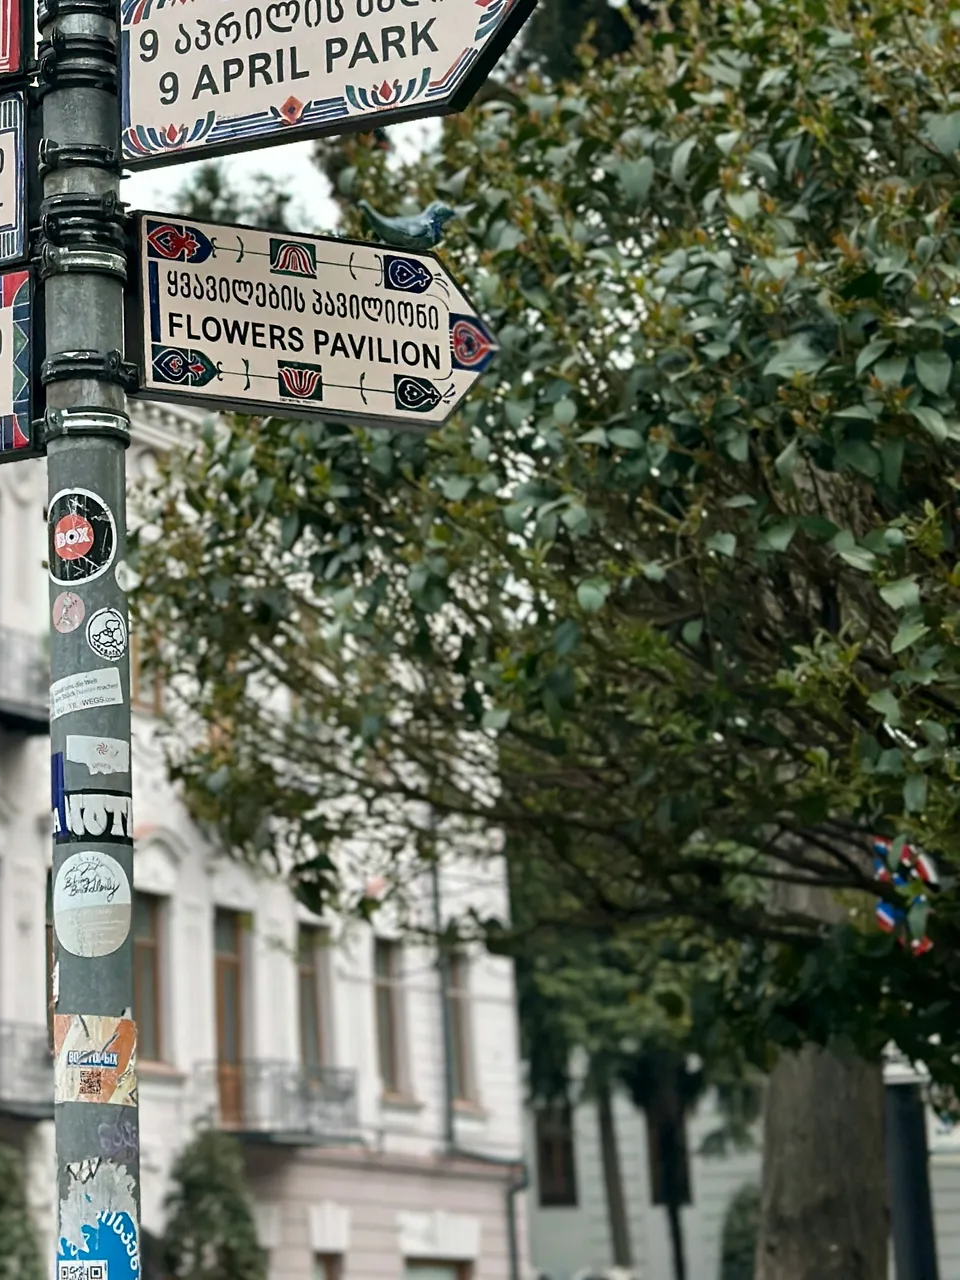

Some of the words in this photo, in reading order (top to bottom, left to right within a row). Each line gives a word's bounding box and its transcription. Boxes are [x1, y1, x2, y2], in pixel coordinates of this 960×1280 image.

[139, 29, 159, 62] 9
[159, 71, 179, 105] 9
[192, 45, 310, 100] APRIL
[326, 17, 438, 73] PARK
[166, 270, 306, 313] ყვავილების
[312, 289, 439, 331] პავილიონი
[168, 312, 304, 352] FLOWERS
[314, 328, 440, 370] PAVILION
[55, 526, 90, 549] BOX
